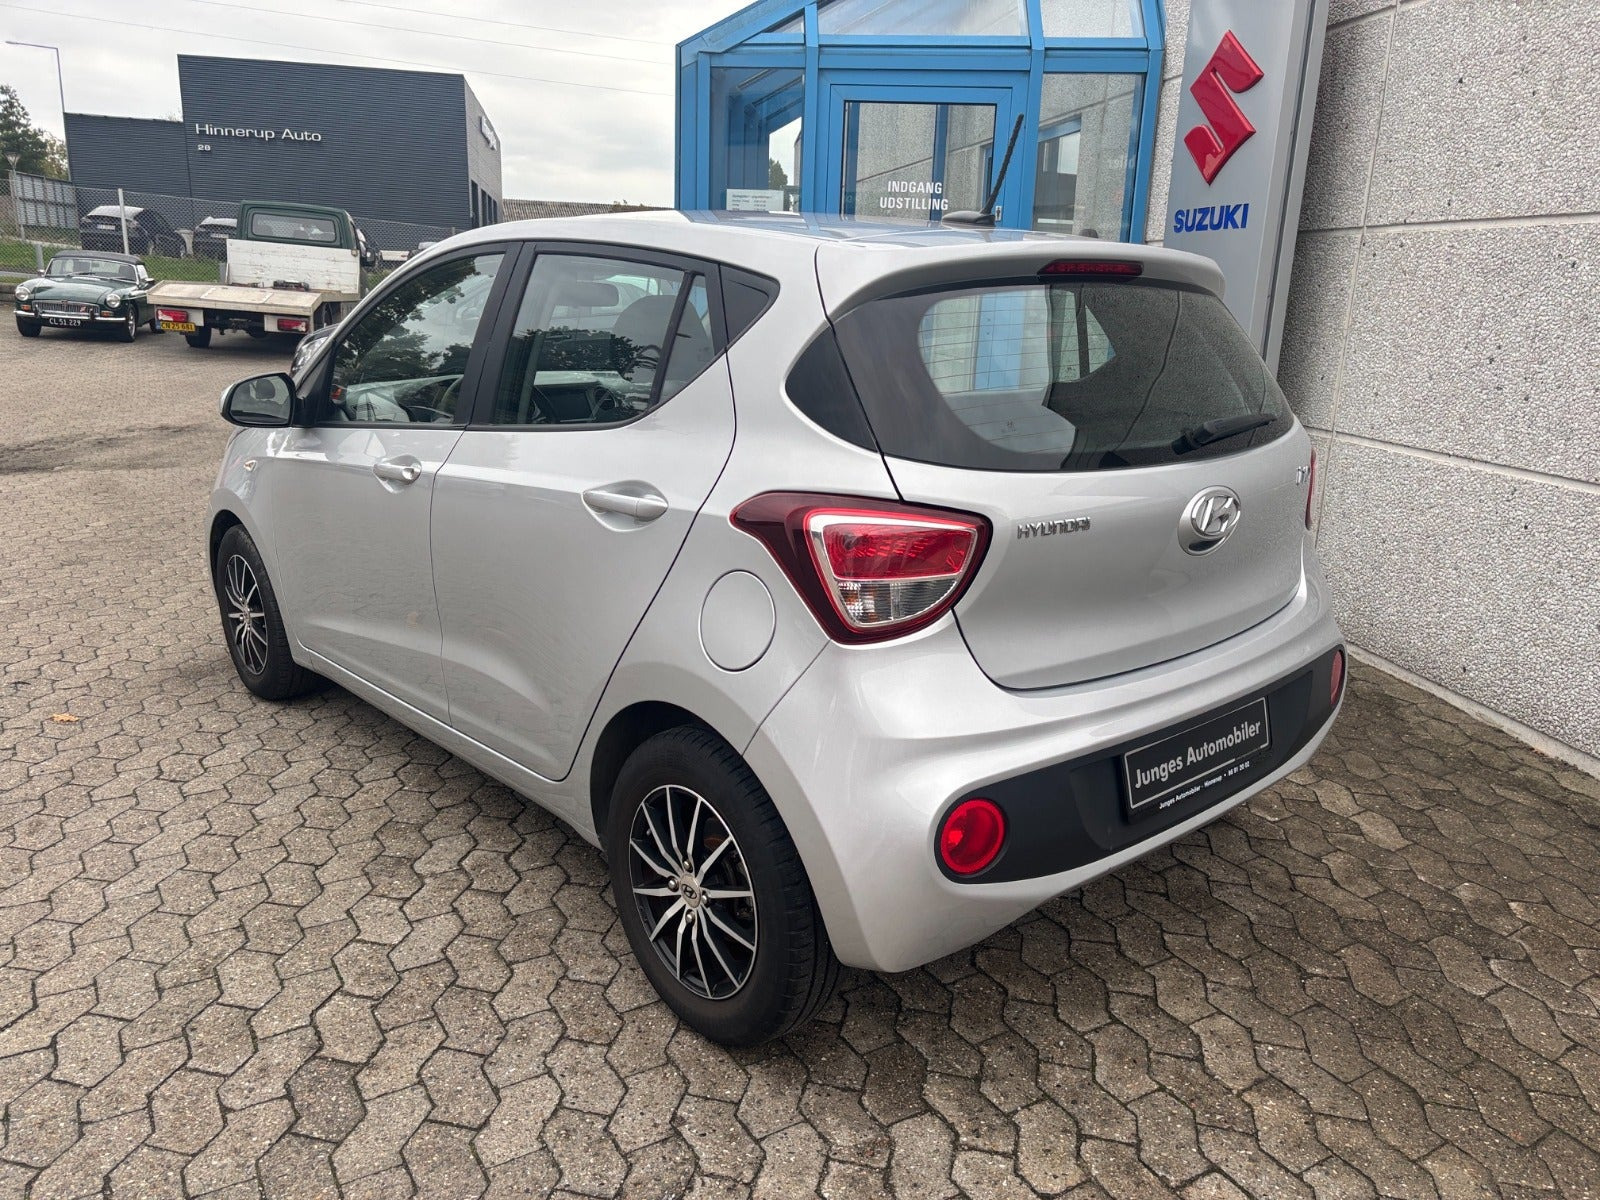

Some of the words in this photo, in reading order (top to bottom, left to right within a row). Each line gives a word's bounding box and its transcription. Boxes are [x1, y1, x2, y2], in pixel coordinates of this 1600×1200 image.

[195, 123, 275, 141] Hinnerup
[281, 128, 322, 142] Auto
[887, 180, 943, 194] INDGANG
[879, 196, 949, 211] UDSTILLING
[1173, 203, 1250, 234] SUZUKI
[49, 317, 59, 326] CL
[1017, 516, 1091, 539] HYUNDAI
[1135, 756, 1183, 788] Junges
[1187, 721, 1261, 765] Automobiler
[1176, 785, 1201, 801] Automobiler
